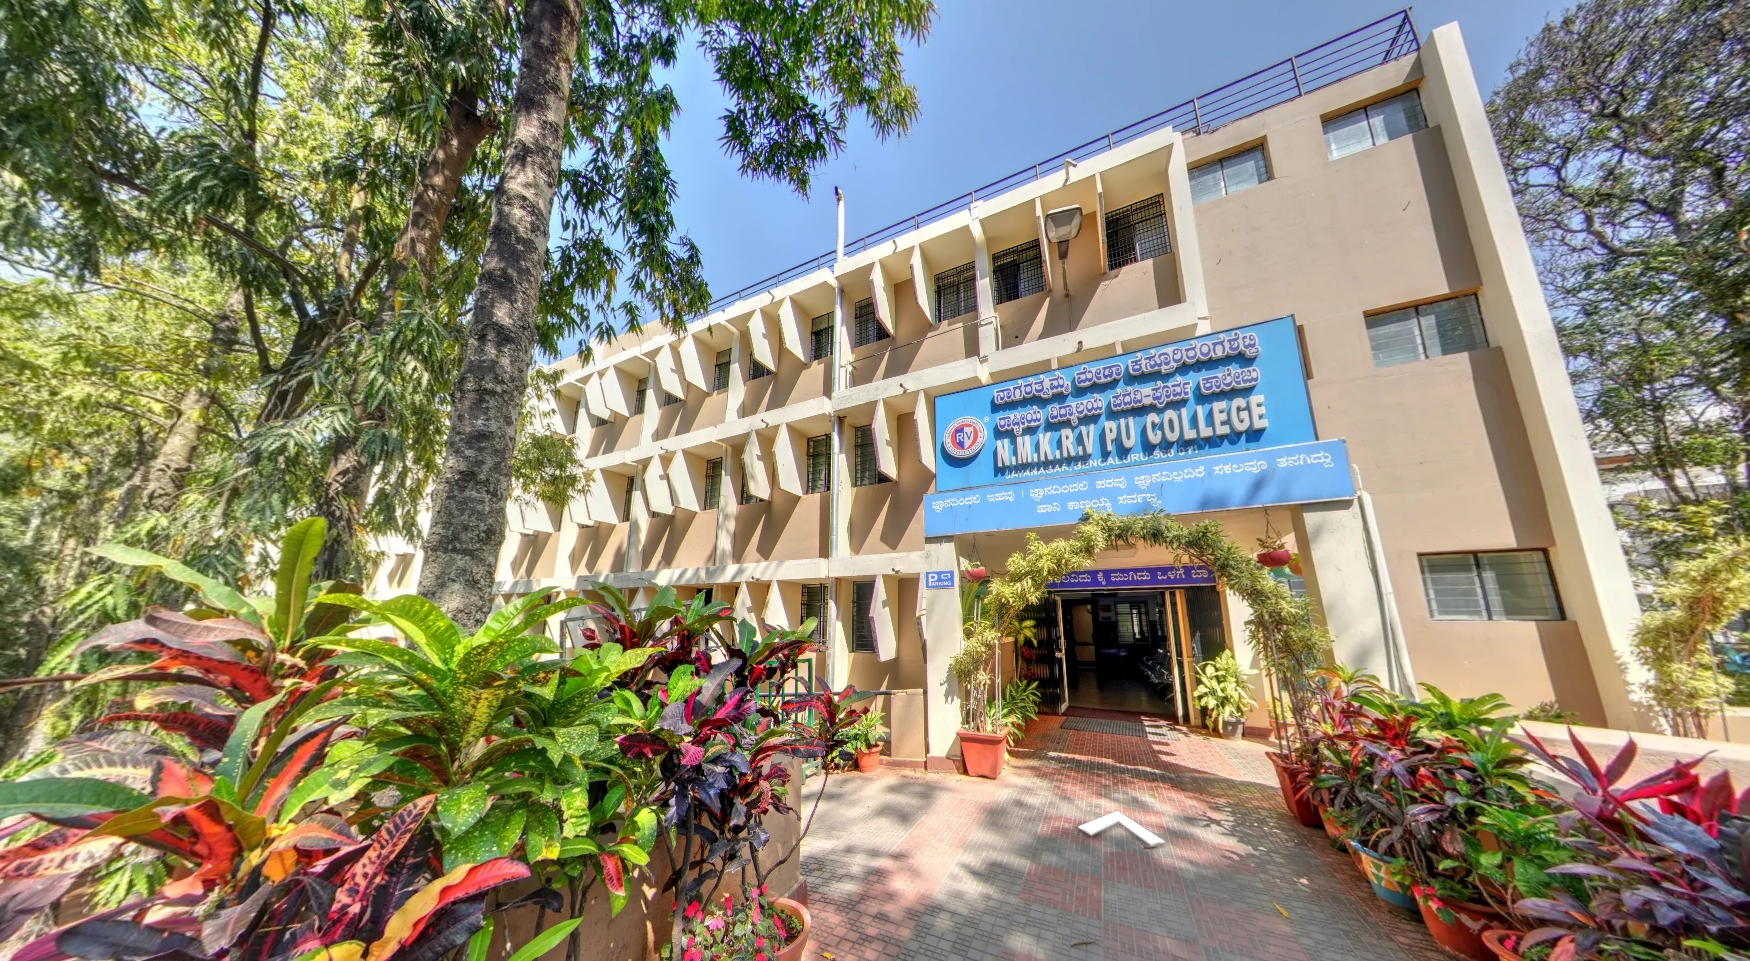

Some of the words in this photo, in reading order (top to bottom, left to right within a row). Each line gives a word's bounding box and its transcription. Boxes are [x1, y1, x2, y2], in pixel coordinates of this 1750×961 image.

[994, 372, 1071, 404] ನಾಗರತ್ನಮ್ಮ
[1075, 363, 1124, 388] ಮೇಡಾ
[997, 406, 1042, 436] ರಾಷ್ಟ್ರೀಯ
[1048, 393, 1104, 427] ವಿದ್ಯಾಲಯ
[1199, 366, 1260, 396] ಕಾಲೇಜು
[996, 423, 1095, 468] N.M.K.R.V
[1104, 416, 1136, 453] PU
[1146, 394, 1269, 446] COLLEGE
[931, 494, 981, 513] ಜ್ಞಾನದಿಂದಲಿ
[1029, 480, 1089, 502] ಜ್ಞಾನದಿಂದಲಿ
[1095, 476, 1127, 489] ಪರವು
[1134, 465, 1205, 490] ಜ್ಞಾನವಿಲ್ಲದಿರೆ
[1213, 459, 1267, 475] ಸಕಲವೂ
[1276, 450, 1334, 468] ತನಗಿದ್ದು
[1037, 502, 1061, 513] ಹಾನಿ
[1118, 492, 1163, 507] ಸರ್ವಜ್ಞ
[1097, 571, 1107, 585] ಕೈ
[1111, 570, 1151, 581] ಮುಗಿದು
[1157, 568, 1185, 580] ಒಳಗೆ
